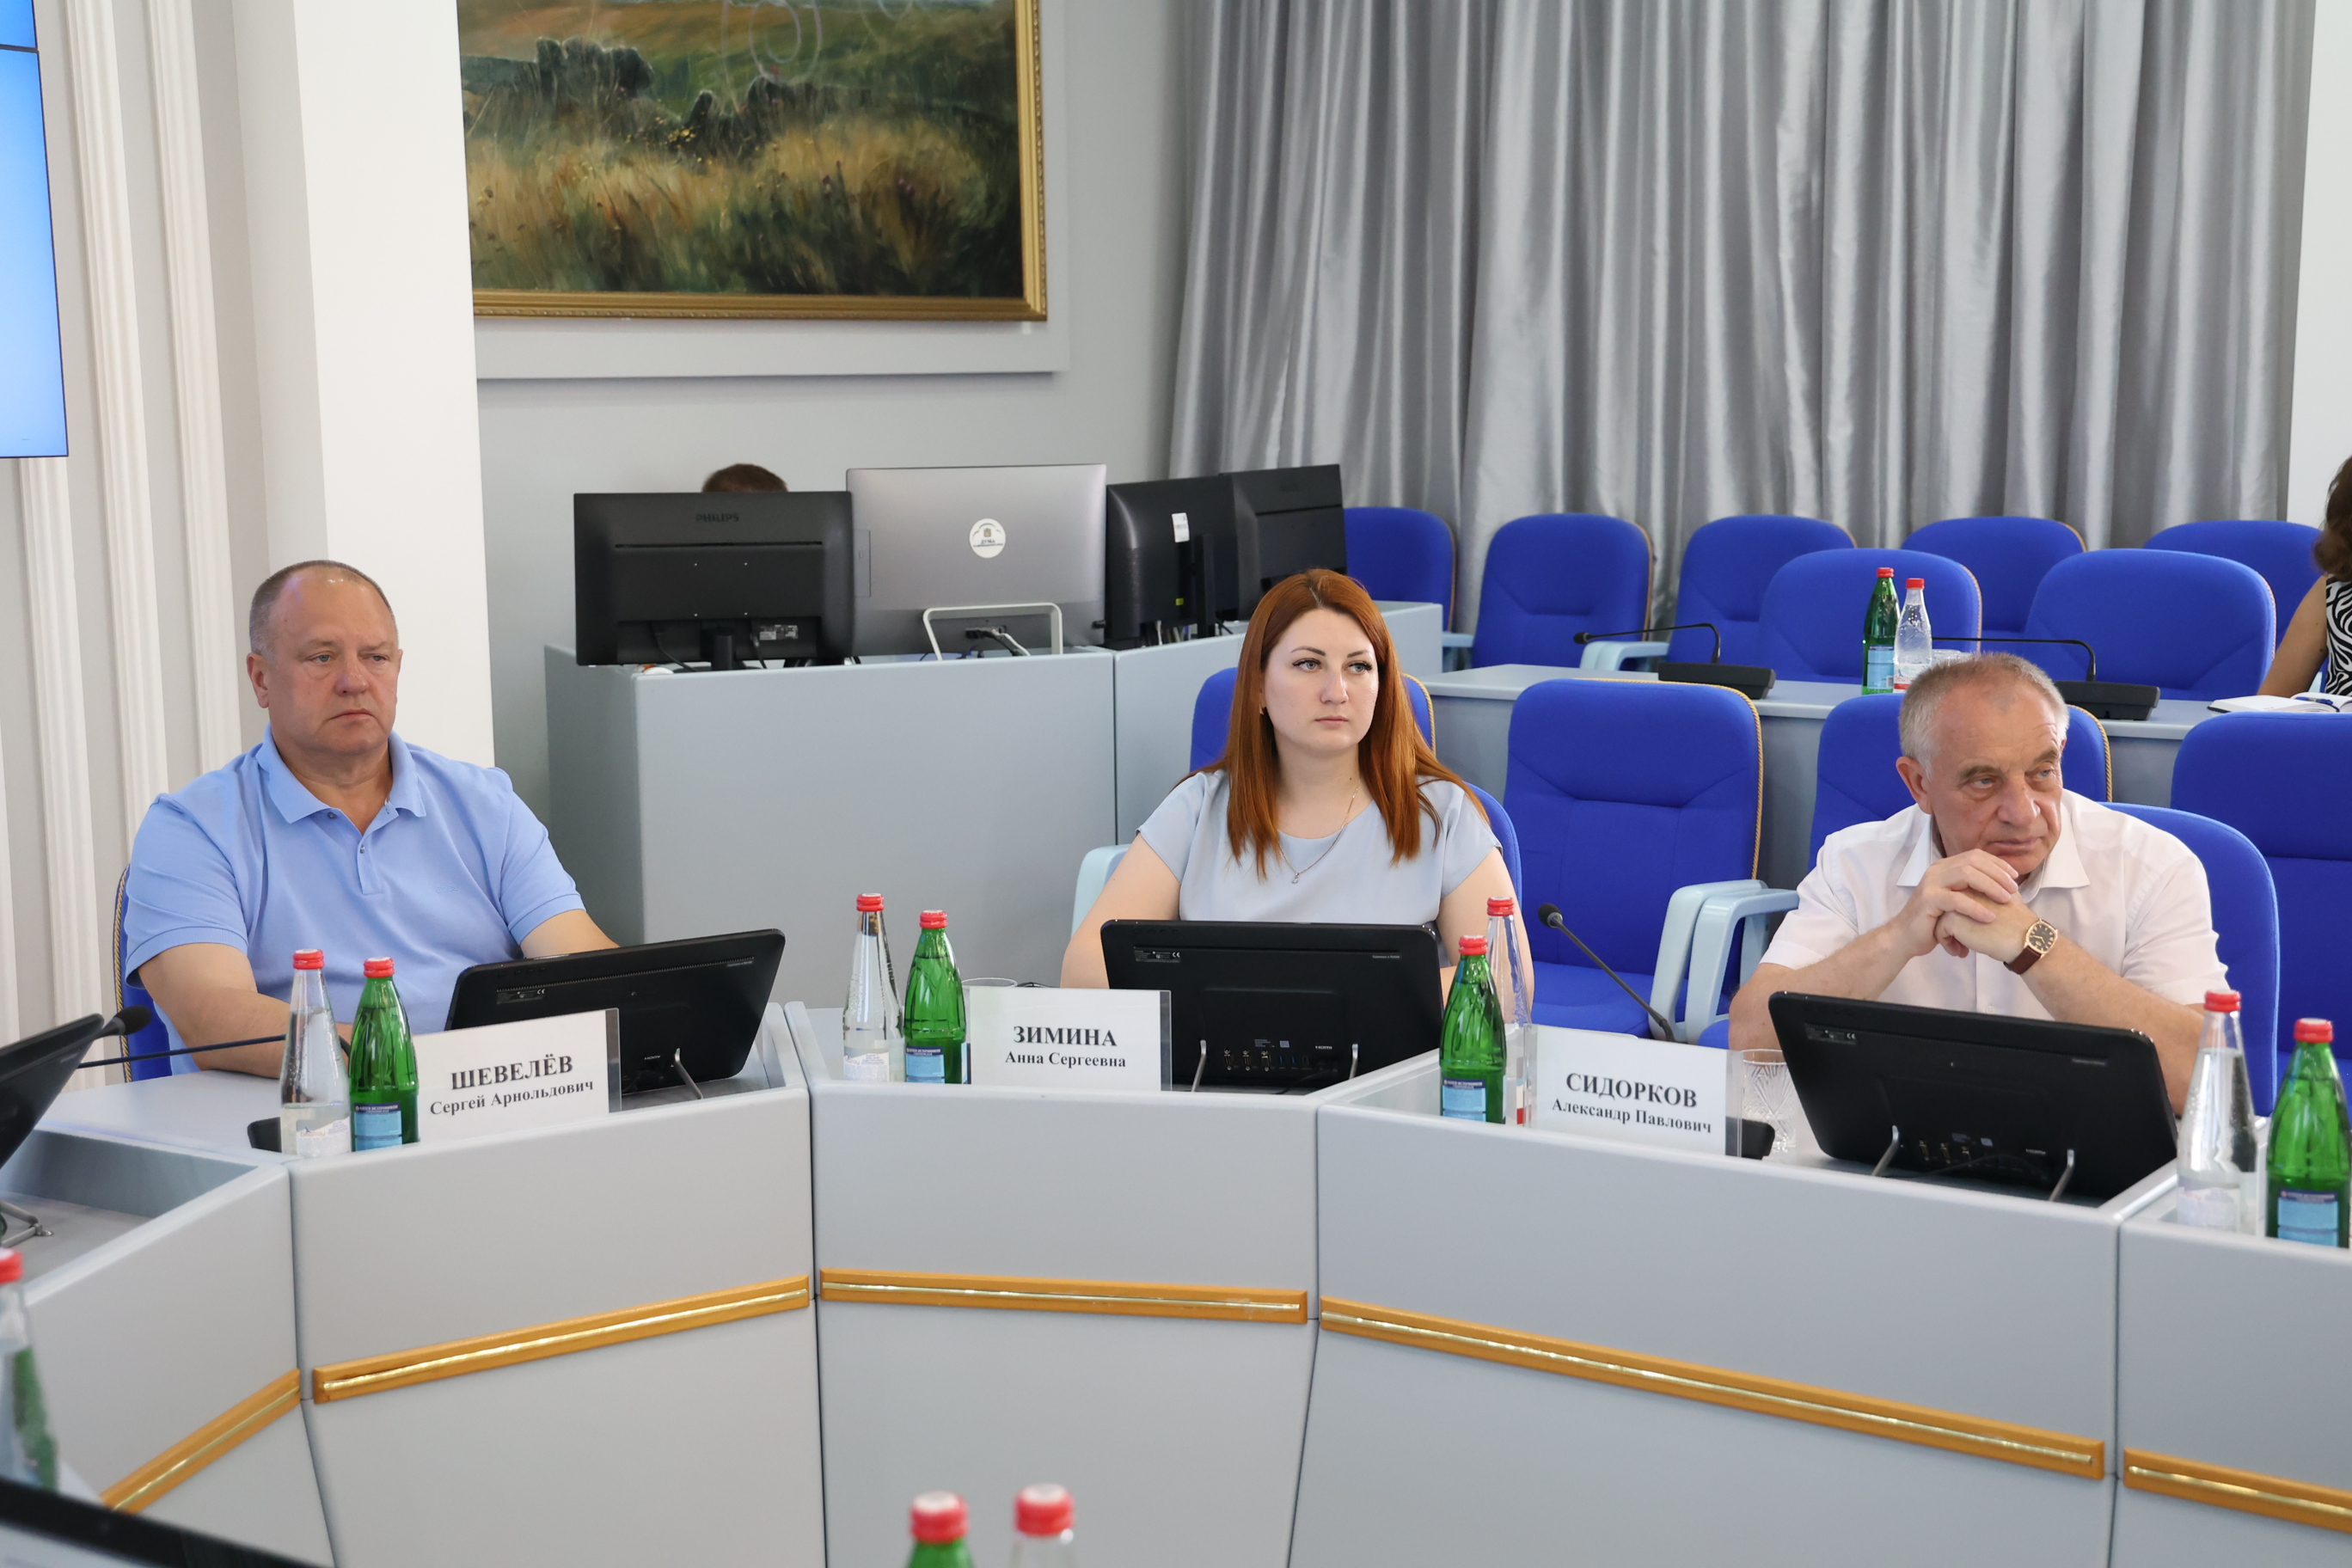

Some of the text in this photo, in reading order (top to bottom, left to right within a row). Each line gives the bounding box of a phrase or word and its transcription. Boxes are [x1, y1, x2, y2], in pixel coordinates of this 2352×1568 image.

[695, 513, 740, 523] PHILIPS
[1013, 1026, 1117, 1046] ЗИМИНА
[450, 1053, 573, 1090] ШЕВЕЛЁВ
[1005, 1050, 1126, 1069] Анна Сергеевна
[430, 1081, 594, 1116] Сергей Арнольдович
[1565, 1072, 1698, 1108] СИДОРКОВ
[1552, 1098, 1712, 1134] Александр Павлович
